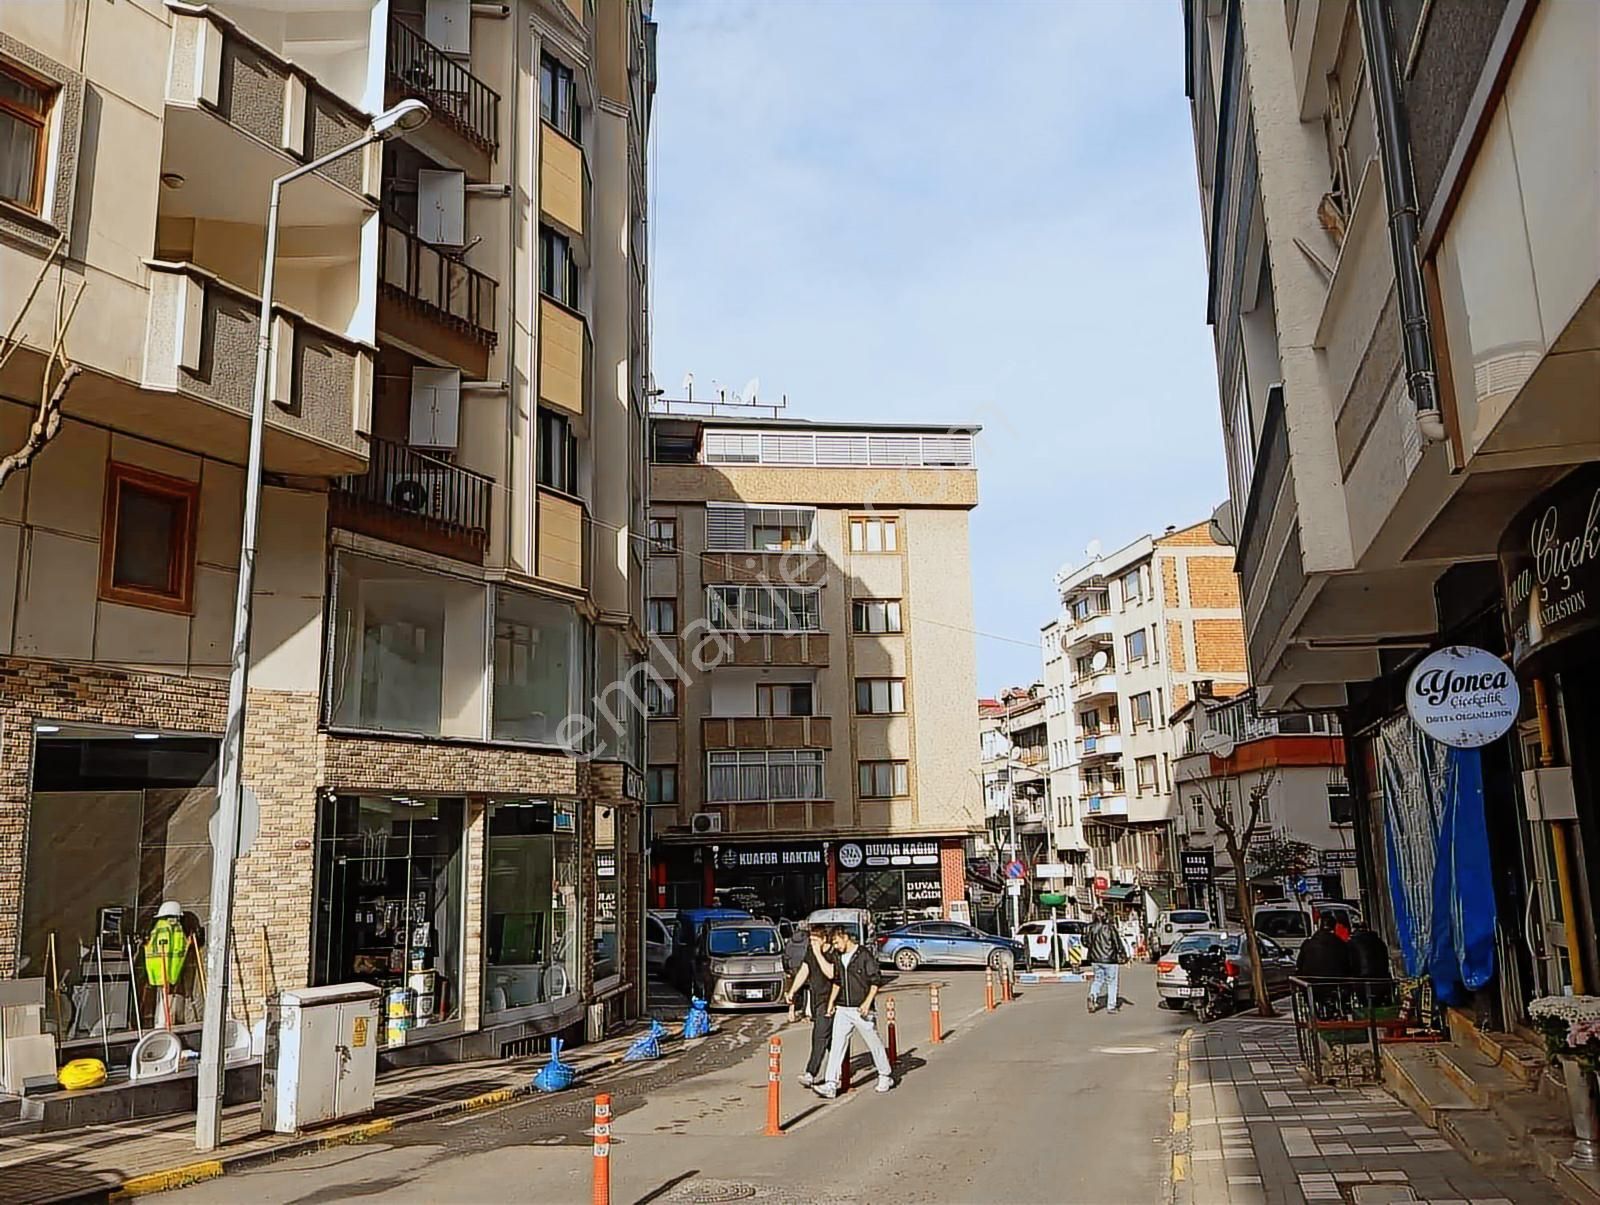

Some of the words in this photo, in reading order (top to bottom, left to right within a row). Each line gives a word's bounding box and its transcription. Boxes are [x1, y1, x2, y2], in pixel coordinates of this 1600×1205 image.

[1415, 669, 1509, 706] Yonca
[865, 844, 900, 856] DUVAR
[902, 842, 938, 855] KAĞIDI
[906, 881, 941, 890] DUVAR
